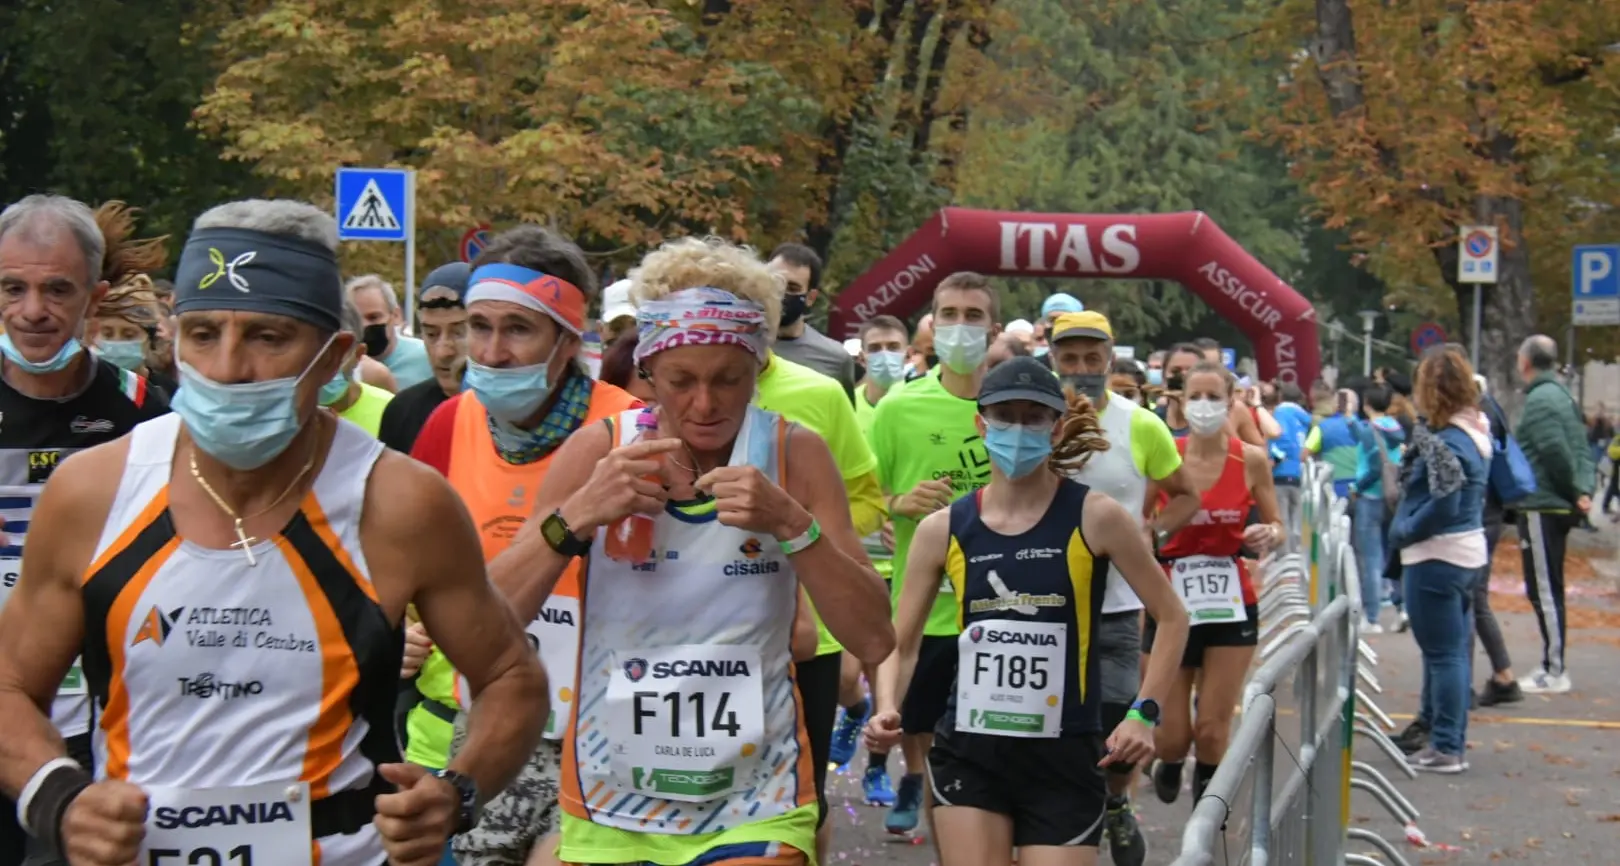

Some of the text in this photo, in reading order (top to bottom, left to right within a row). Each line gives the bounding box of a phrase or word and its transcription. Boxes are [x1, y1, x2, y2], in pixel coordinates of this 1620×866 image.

[998, 221, 1141, 274] ITAS
[1581, 251, 1612, 293] P
[1197, 260, 1298, 385] ASSICUR AZIO
[1183, 575, 1230, 598] F157
[186, 607, 273, 625] ATLETICA
[536, 607, 575, 627] NIA
[187, 630, 316, 652] Valle di Cembra
[987, 630, 1058, 647] SCANIA
[652, 660, 750, 678] SCANIA
[973, 652, 1049, 690] F185
[177, 673, 264, 700] TRENTINO
[633, 691, 741, 737] F114
[655, 745, 680, 757] CARLA
[682, 746, 692, 757] DE
[155, 801, 294, 829] SCANIA
